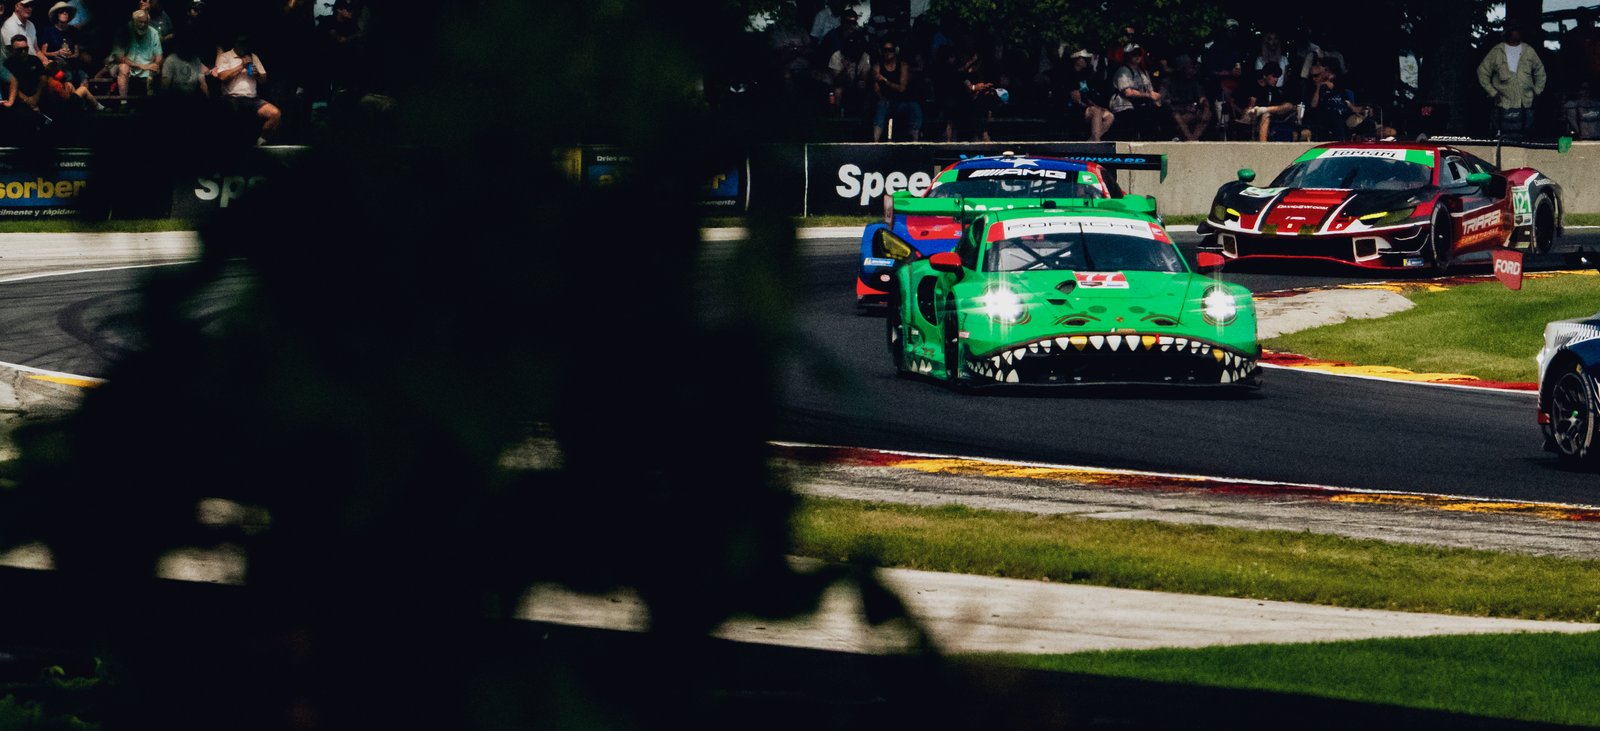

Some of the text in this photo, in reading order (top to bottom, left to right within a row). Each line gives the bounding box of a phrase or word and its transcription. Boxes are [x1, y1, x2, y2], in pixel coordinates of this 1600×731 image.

[1332, 150, 1396, 158] Ferrari
[999, 168, 1066, 180] AMG
[1512, 192, 1531, 214] 021
[1007, 222, 1148, 232] PORSCHE
[1494, 258, 1521, 275] FORD
